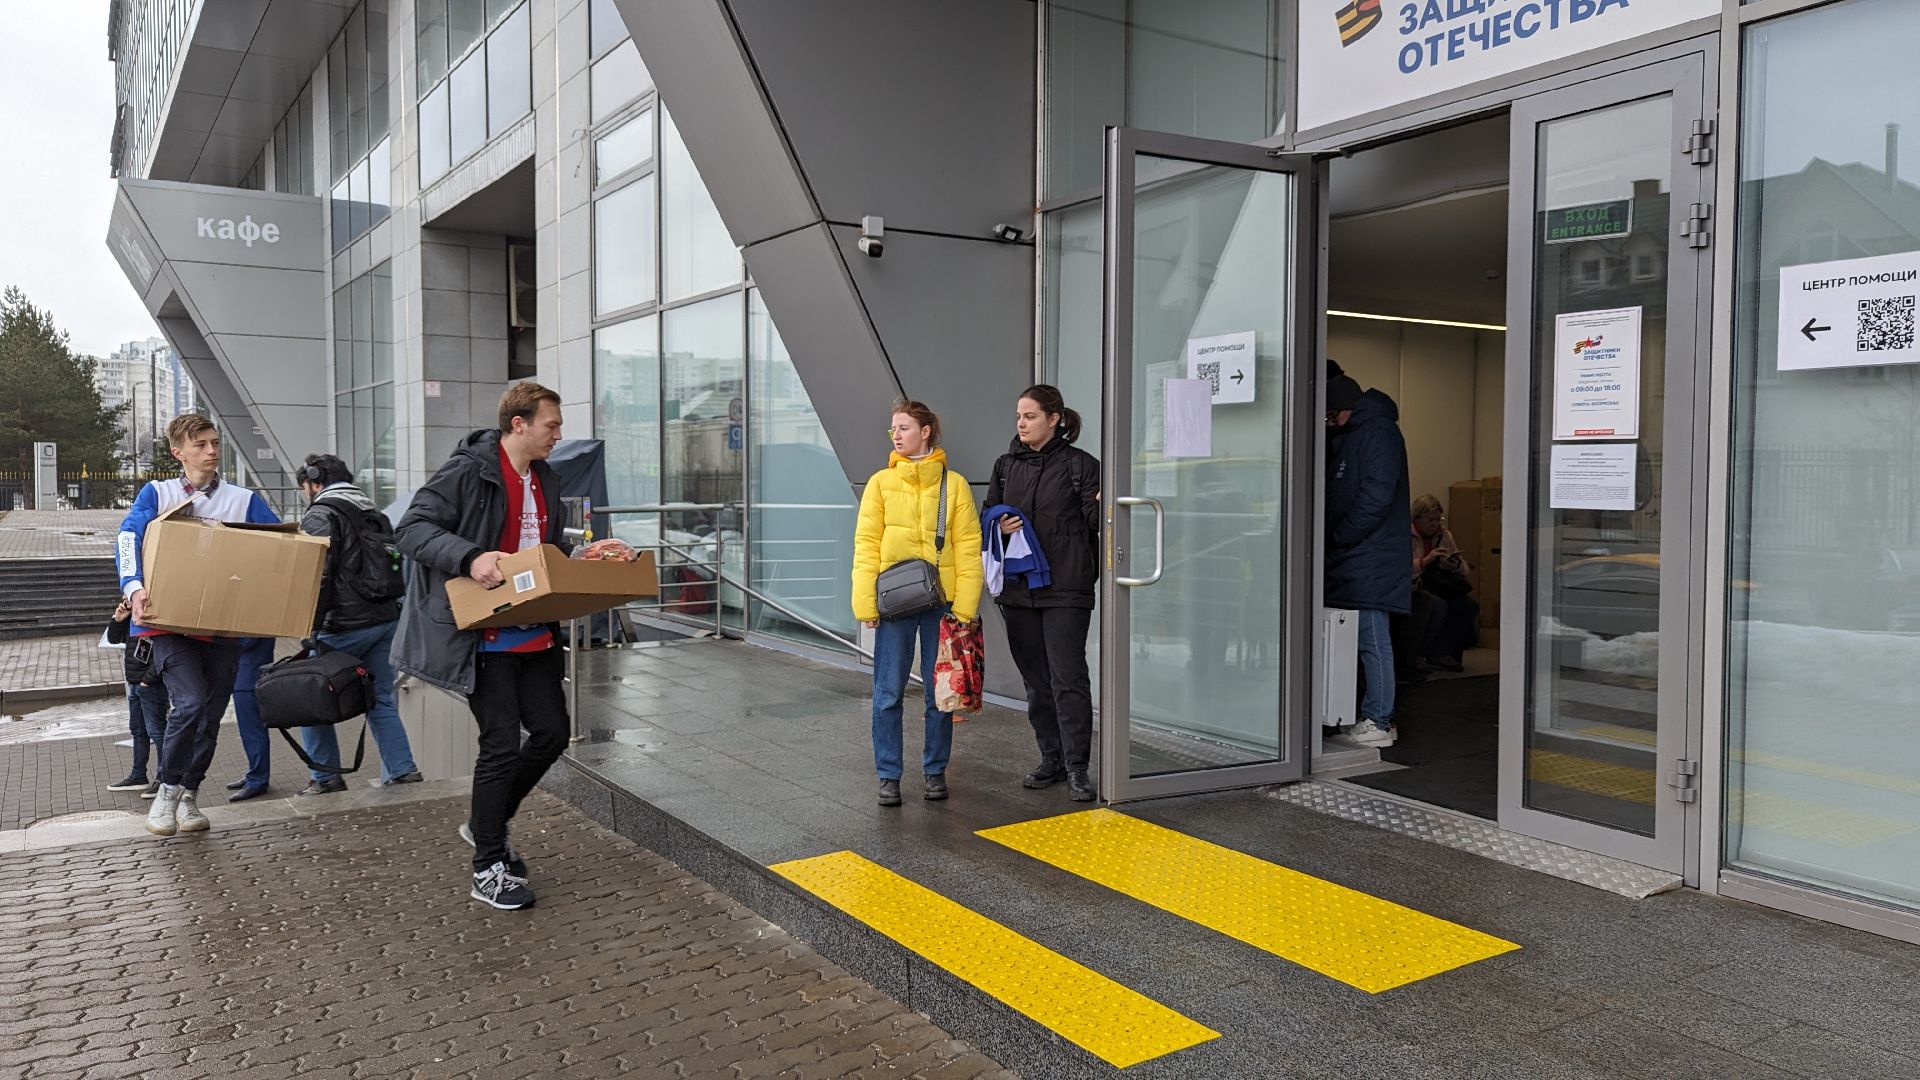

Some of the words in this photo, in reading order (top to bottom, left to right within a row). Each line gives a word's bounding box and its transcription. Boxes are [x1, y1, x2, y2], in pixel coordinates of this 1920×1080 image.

[1399, 0, 1496, 36] ЗАЩ
[1565, 207, 1609, 223] ВХОД
[197, 215, 280, 248] кафе
[1551, 221, 1621, 238] ENTRANCE
[1802, 278, 1846, 291] ЦЕНТР
[1849, 269, 1917, 286] ПОМОЩИ
[1197, 347, 1216, 356] ЦЕНТР
[1216, 343, 1245, 353] ПОМОЩИ
